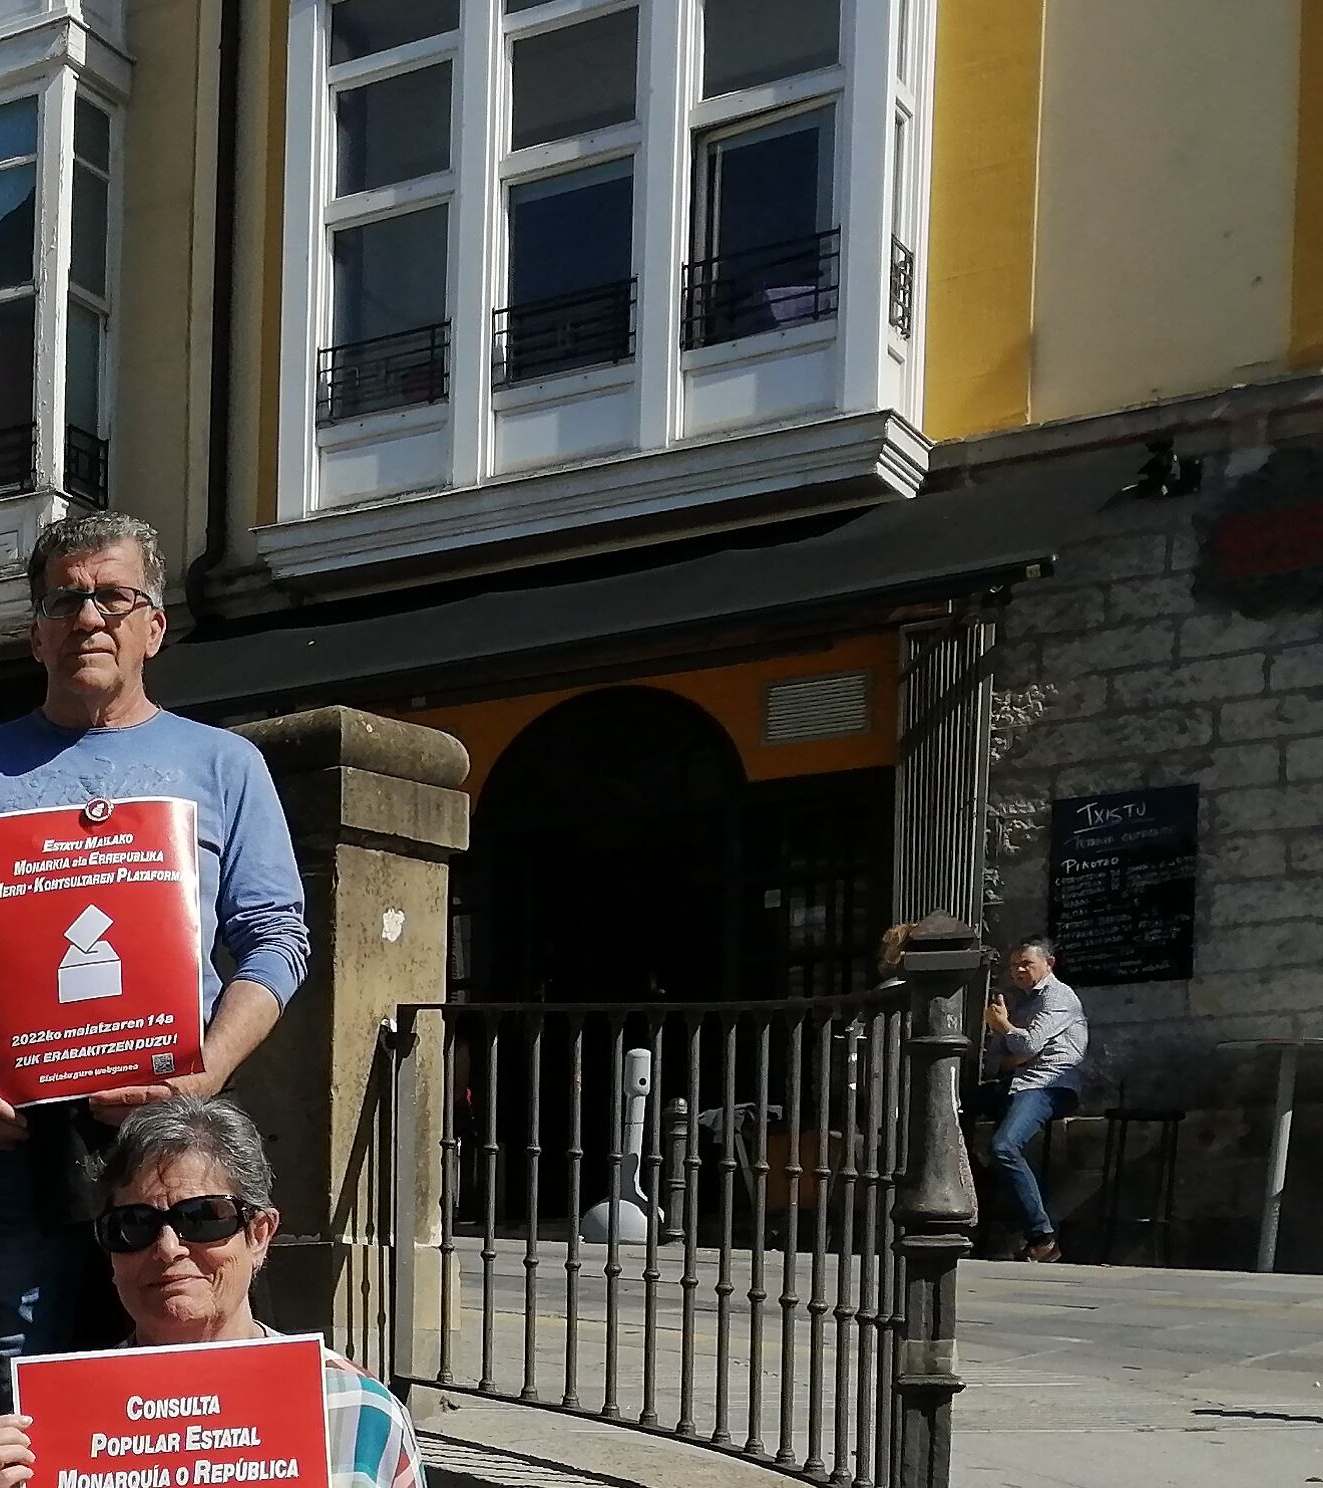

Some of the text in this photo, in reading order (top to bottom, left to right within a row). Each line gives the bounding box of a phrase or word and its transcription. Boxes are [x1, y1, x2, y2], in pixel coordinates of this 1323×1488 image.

[127, 1395, 220, 1420] CONSULTA
[91, 1425, 261, 1457] POPULAR ESTATAL
[193, 1458, 299, 1484] REPÚBLICA
